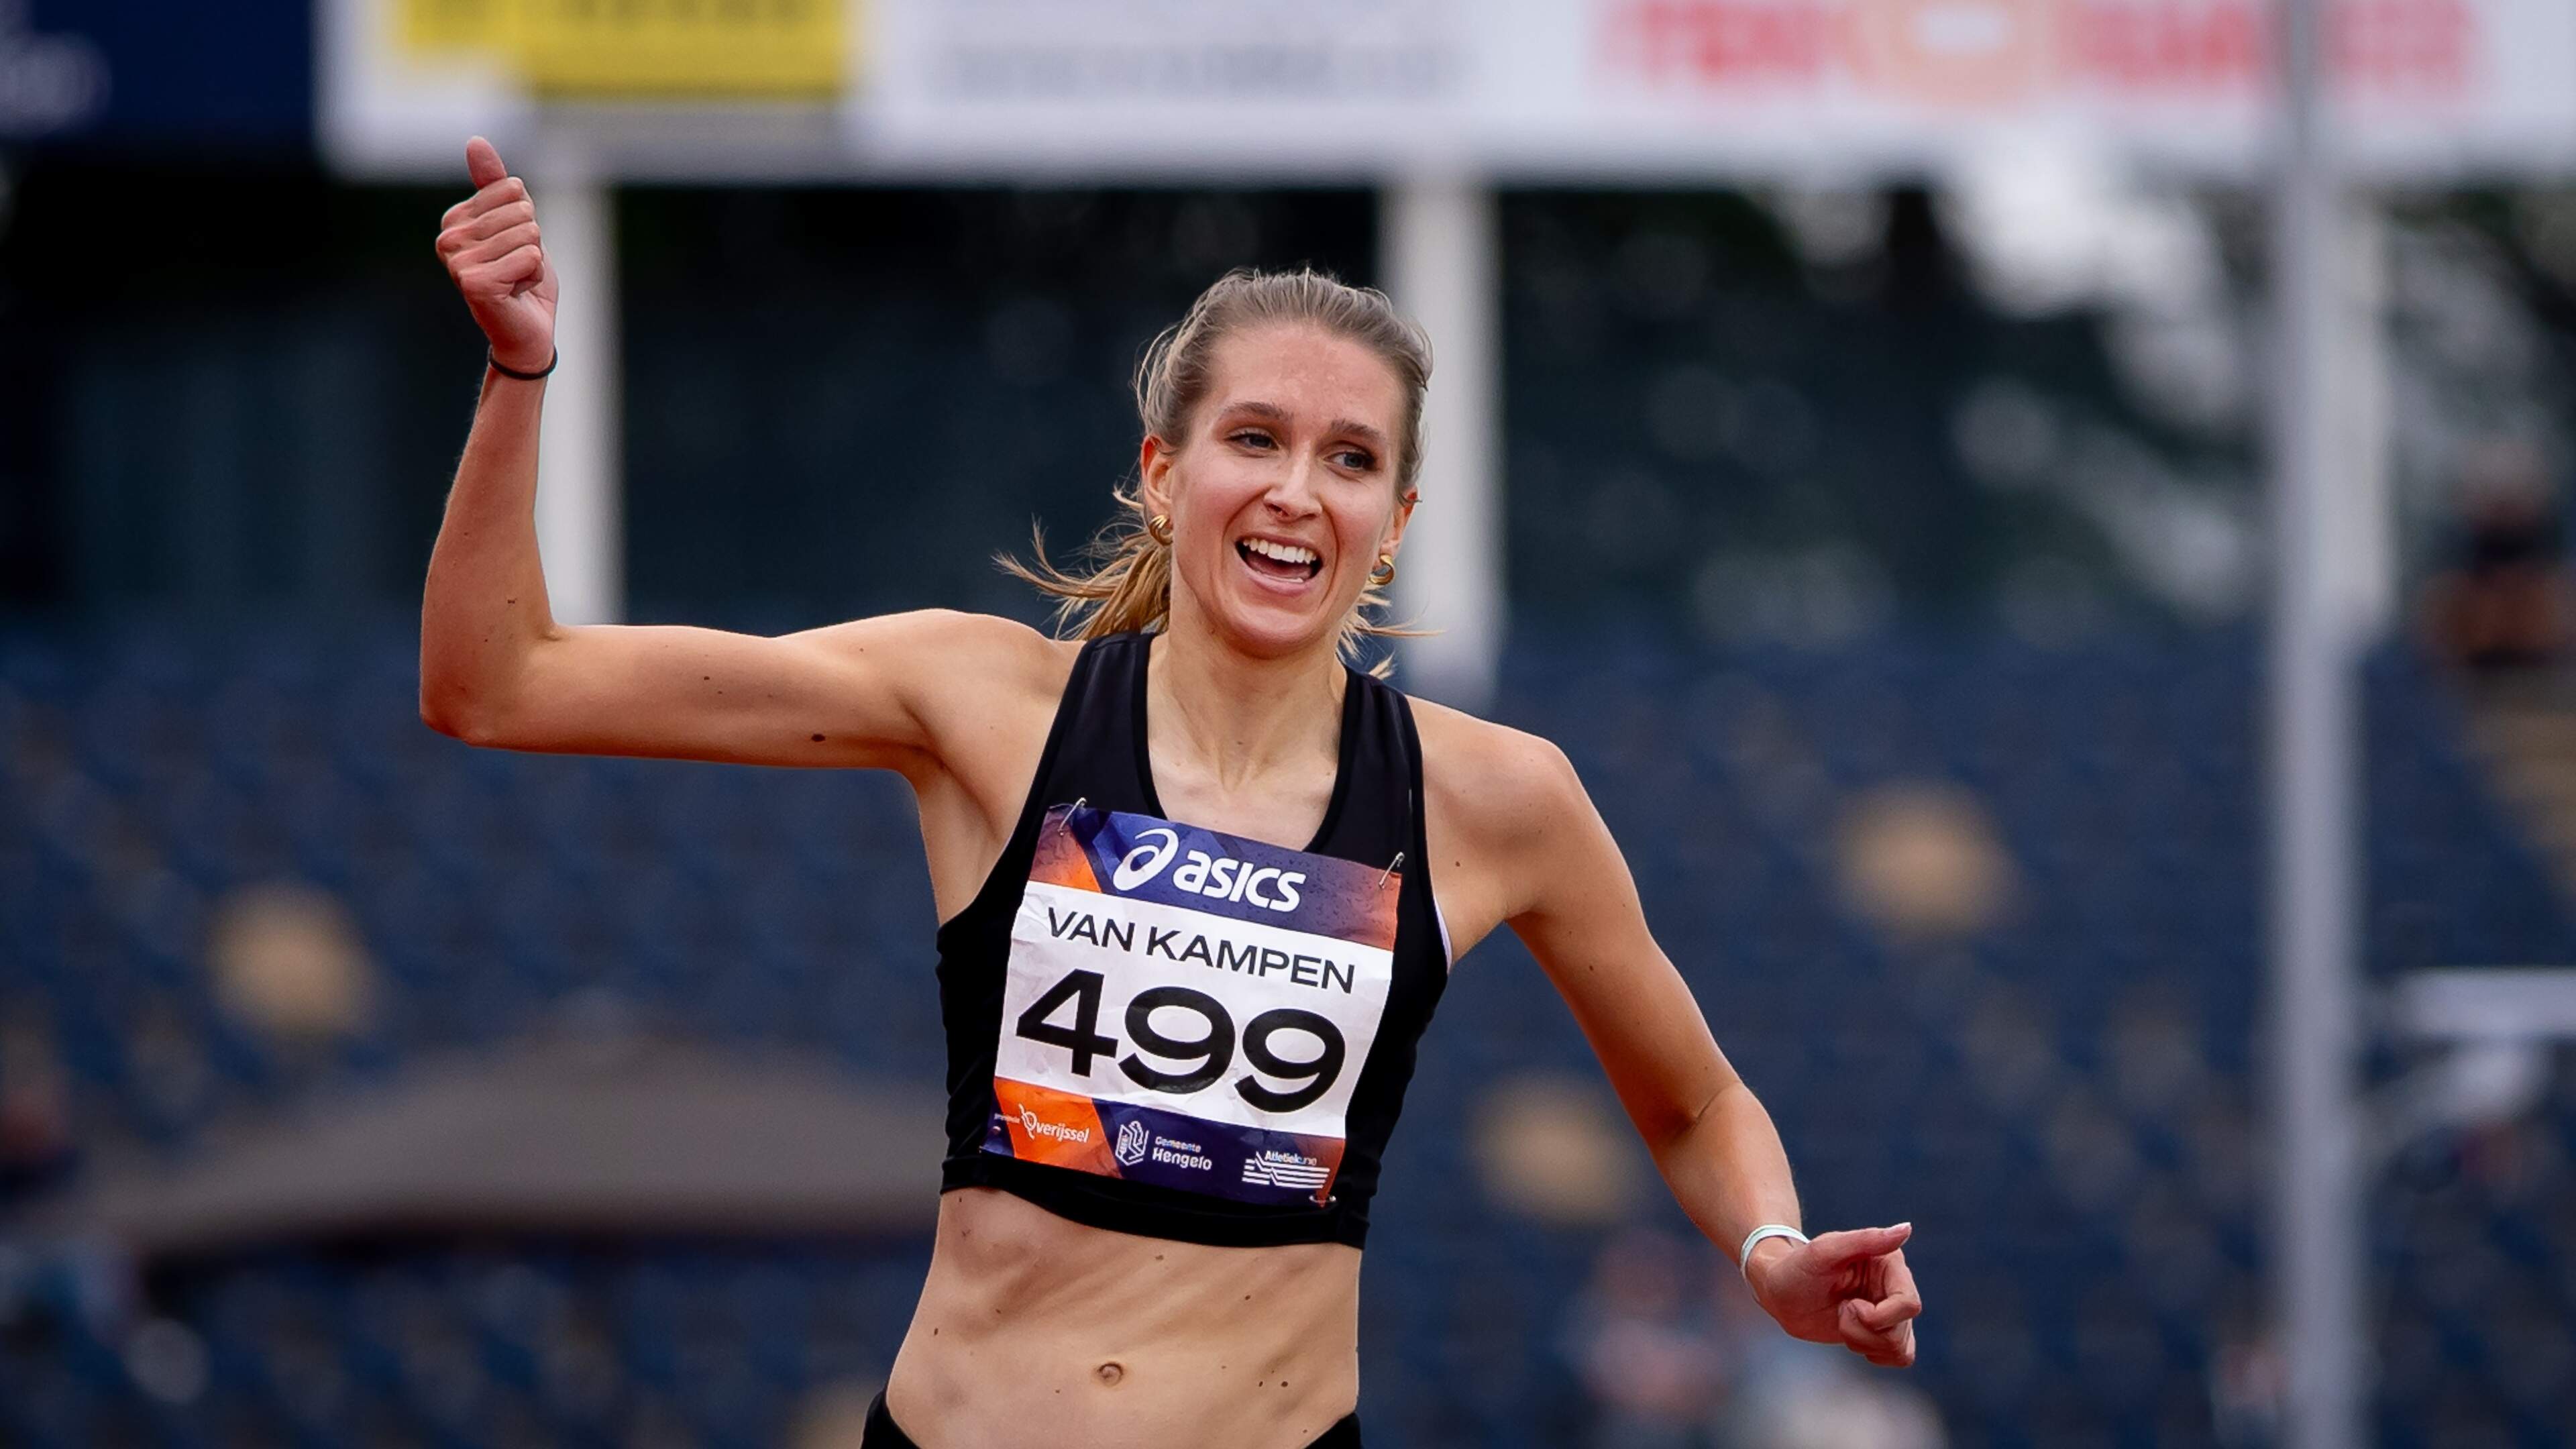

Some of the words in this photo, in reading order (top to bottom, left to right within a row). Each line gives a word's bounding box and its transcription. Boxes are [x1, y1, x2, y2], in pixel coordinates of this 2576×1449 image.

[1047, 907, 1135, 952] VAN
[1146, 926, 1354, 994] KAMPEN
[1016, 968, 1345, 1113] 499
[1019, 1104, 1090, 1143] Overijssel
[1152, 1147, 1212, 1171] Hengelo
